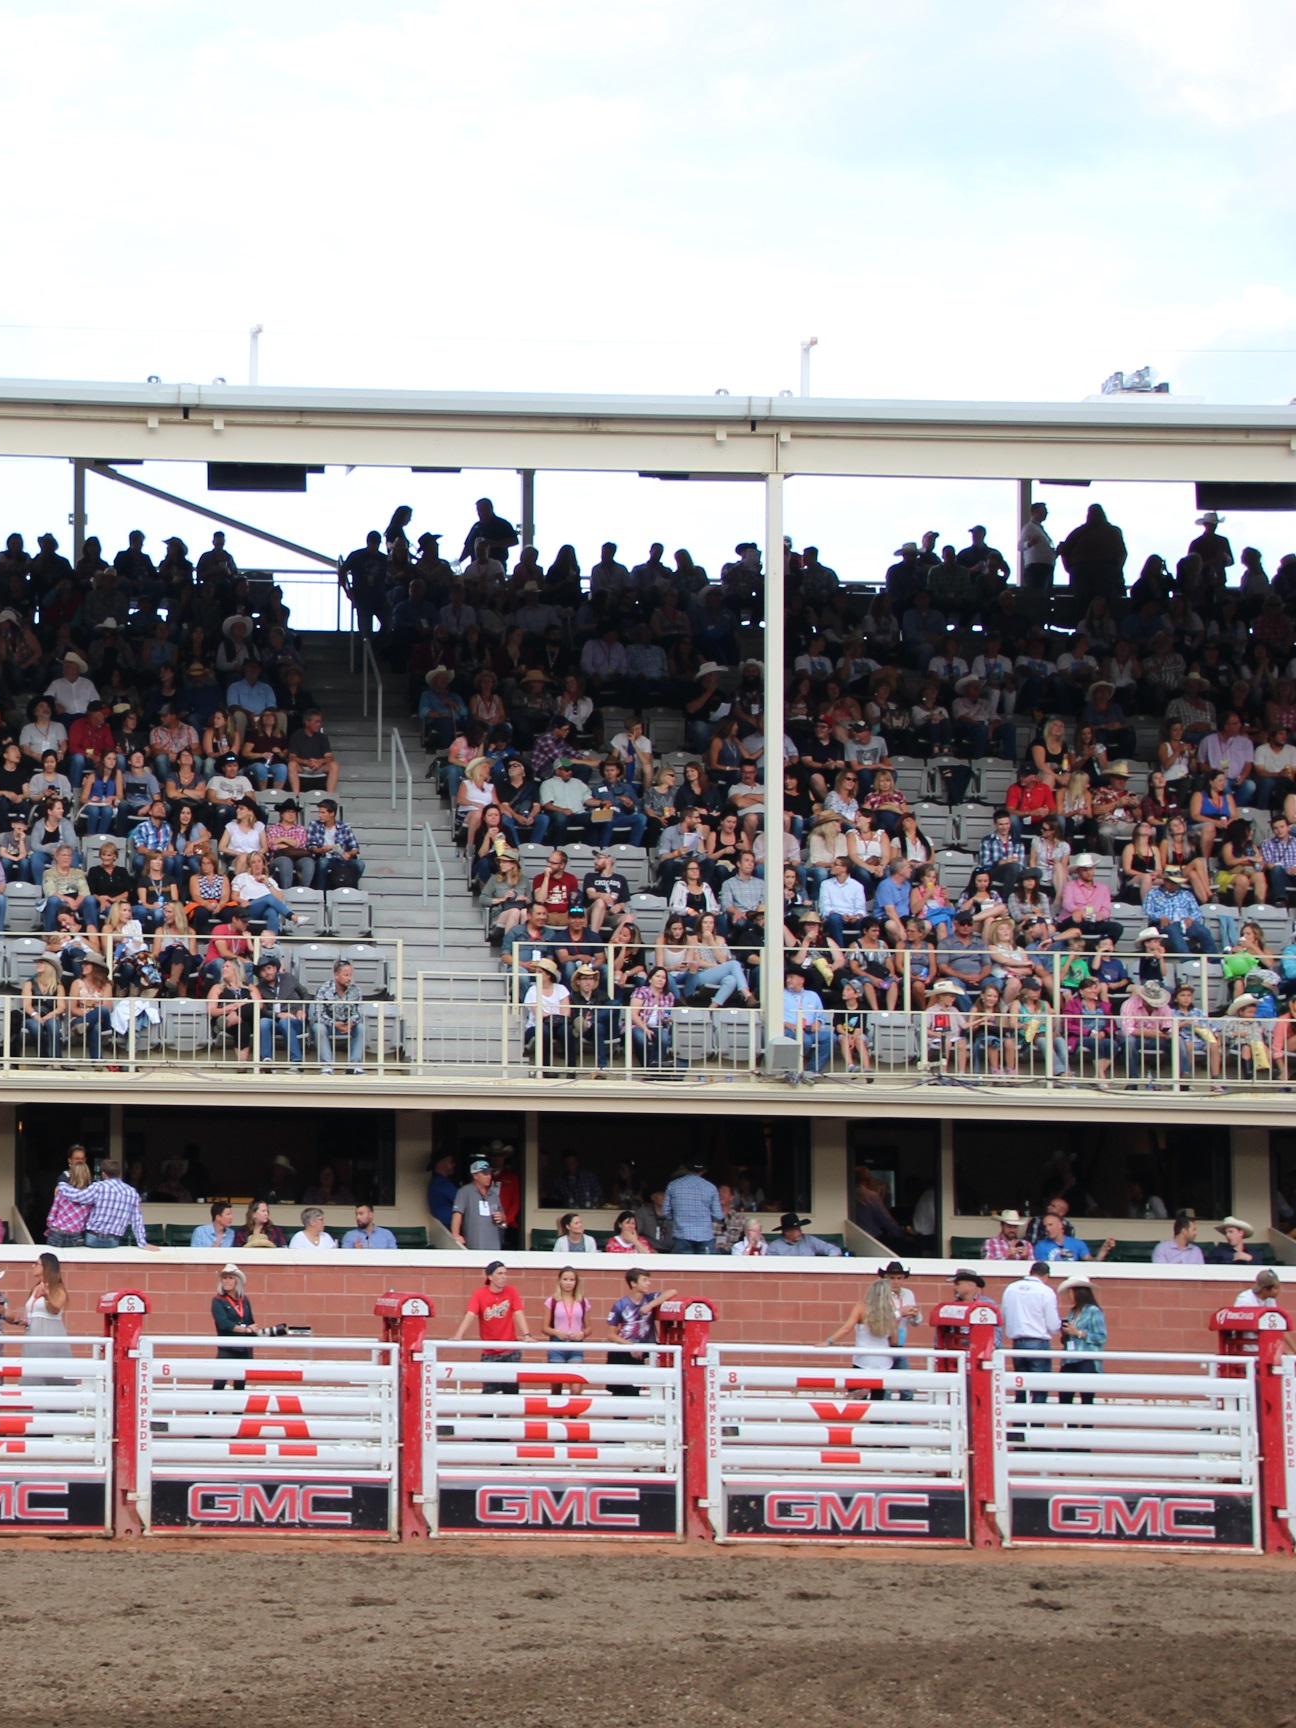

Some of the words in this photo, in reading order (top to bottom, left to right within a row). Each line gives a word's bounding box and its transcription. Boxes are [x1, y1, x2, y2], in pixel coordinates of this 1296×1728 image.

[162, 1364, 170, 1375] 6
[445, 1367, 453, 1378] 7
[728, 1372, 737, 1383] 8
[1015, 1376, 1023, 1388] 9
[139, 1362, 149, 1452] STAMPEDE
[424, 1363, 433, 1442] CALGARY
[708, 1369, 717, 1459] STAMPEDE
[994, 1373, 1003, 1451] CALGARY
[1284, 1377, 1294, 1468] STAMPEDE
[188, 1483, 352, 1525] GMC
[476, 1485, 640, 1526] GMC
[764, 1491, 929, 1533] GMC
[1049, 1494, 1215, 1539] GMC
